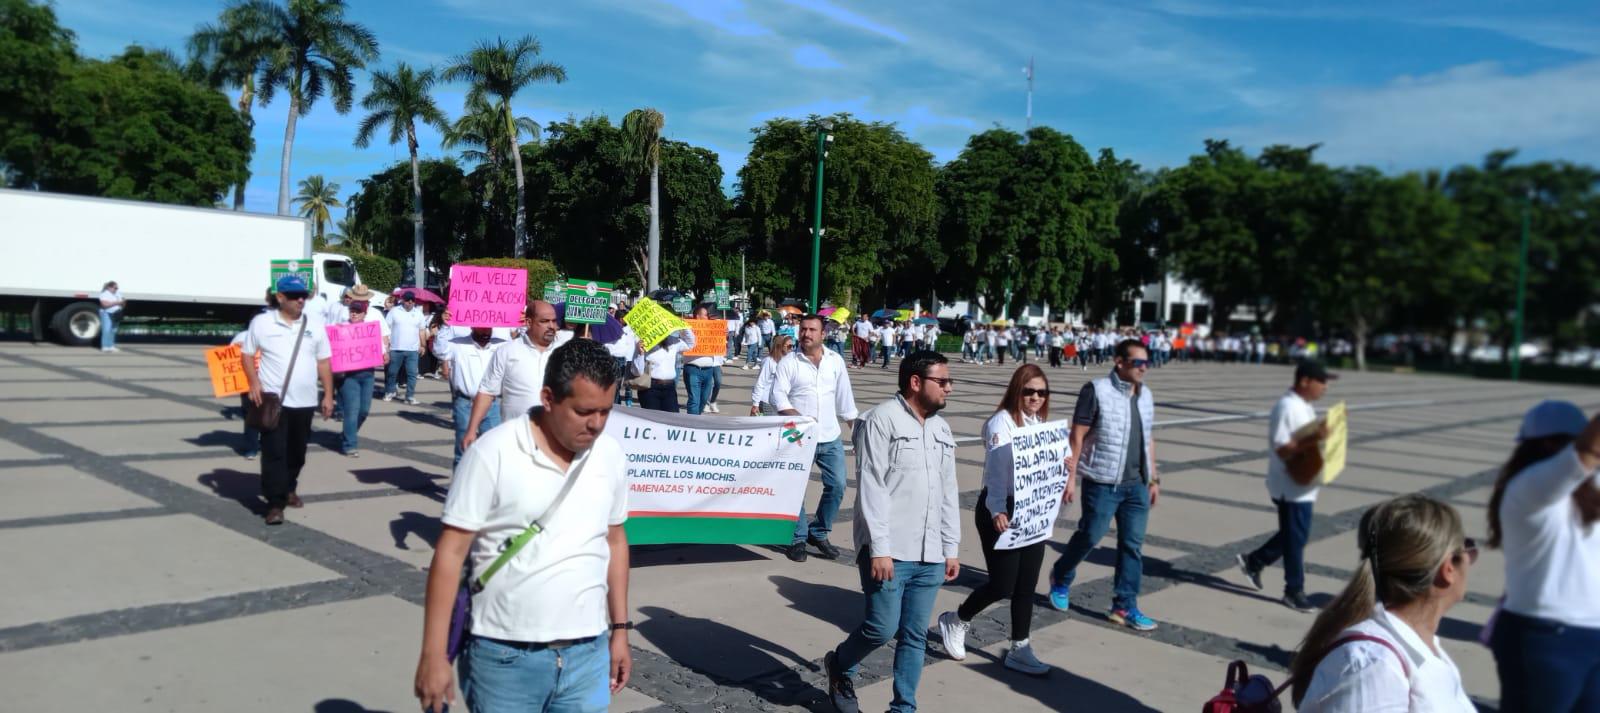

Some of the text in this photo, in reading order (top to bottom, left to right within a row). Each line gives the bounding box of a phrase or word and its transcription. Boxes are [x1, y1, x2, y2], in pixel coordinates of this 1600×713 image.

[460, 271, 518, 286] WIL VELIZ
[450, 289, 525, 305] ALTO AL ACOSO
[455, 309, 511, 324] LABORAL
[349, 324, 377, 340] VELIZ
[214, 346, 241, 361] WIL
[624, 427, 754, 447] LIC. WIL VELIZ
[626, 452, 806, 471] OMISIÓN EVALUADORA DOCENTE DEL
[1015, 449, 1059, 471] SALARIAL
[627, 468, 737, 482] PLANTEL LOS MOCHIS.
[630, 484, 775, 496] AMENAZAS Y ACOSO LABORAL
